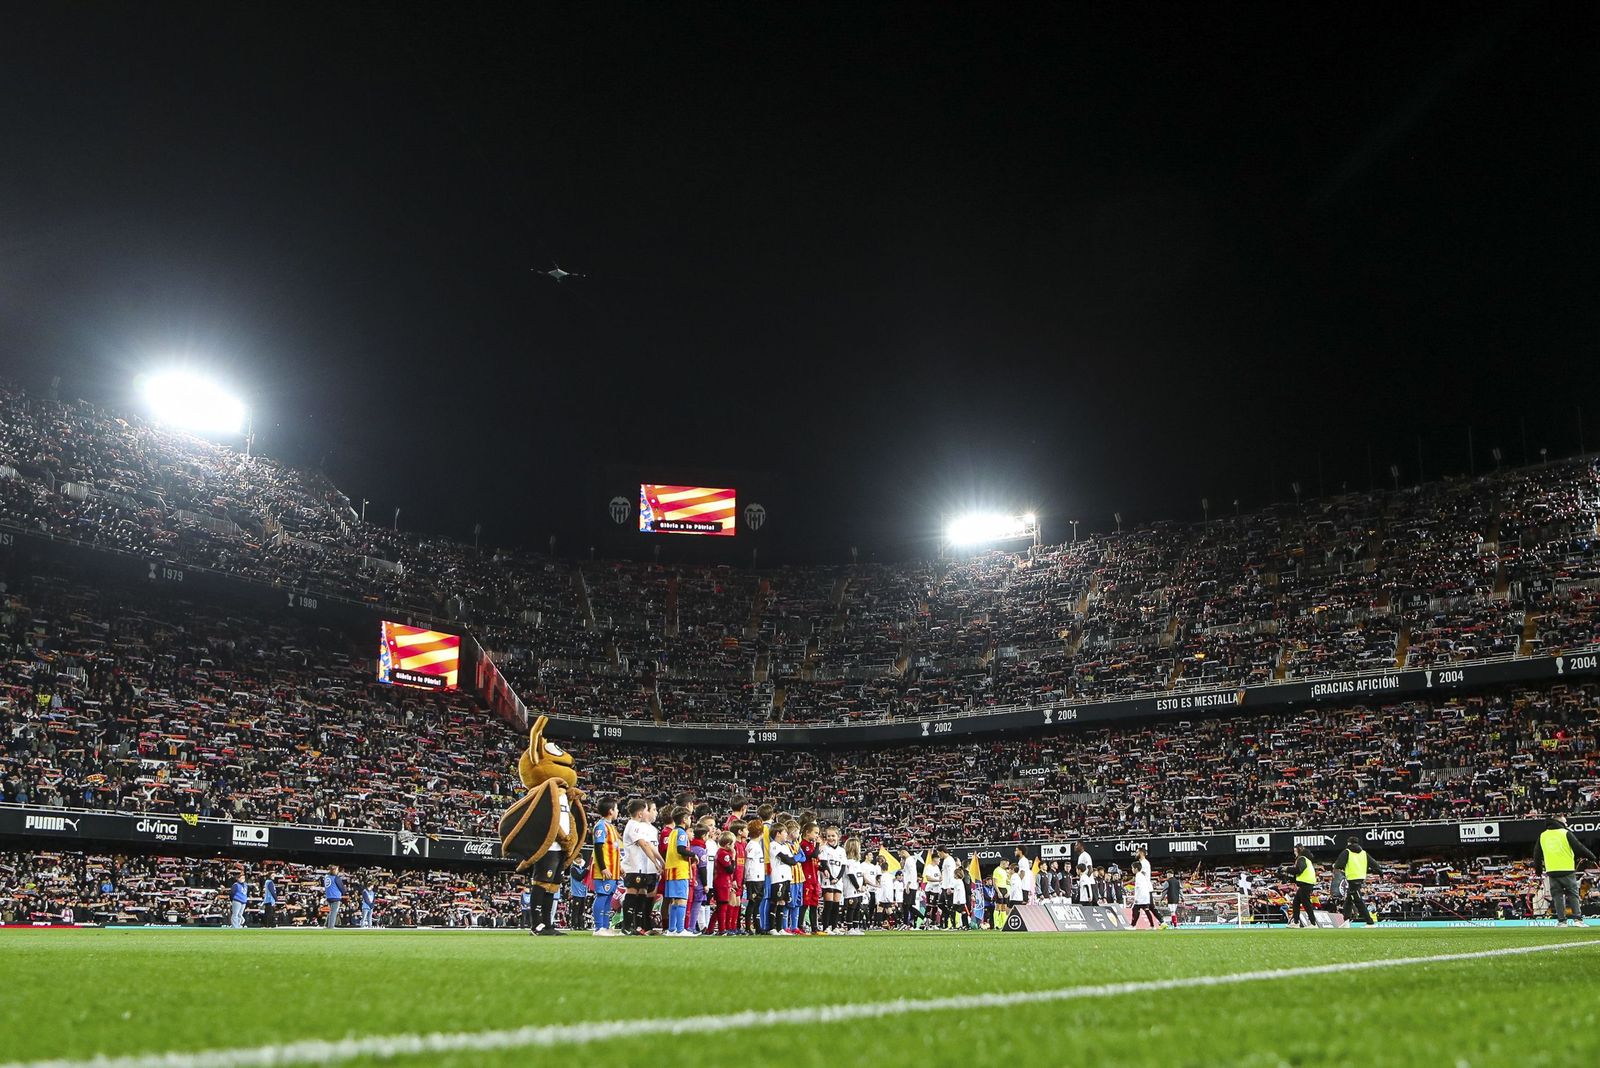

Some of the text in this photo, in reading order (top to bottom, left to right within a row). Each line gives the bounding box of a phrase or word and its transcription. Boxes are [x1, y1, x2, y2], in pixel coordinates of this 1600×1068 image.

[162, 567, 184, 582] 1979
[299, 596, 318, 609] 1980
[1570, 656, 1597, 670] 2004
[1439, 670, 1464, 683] 2004
[1311, 675, 1399, 698] ¡GRACIAS AFICIÓN!
[1157, 693, 1239, 711] ESTO ES MESTALLA
[1057, 709, 1077, 721] 2004
[603, 726, 622, 737] 1999
[934, 722, 952, 733] 2002
[758, 731, 777, 742] 1999
[1019, 767, 1050, 776] SKODA
[25, 815, 65, 831] PUMA
[136, 819, 178, 834] divina
[1567, 823, 1600, 832] KODA
[155, 833, 177, 841] seguros
[235, 829, 248, 838] TM
[1366, 828, 1404, 841] divina
[314, 836, 354, 847] SKODA
[1115, 840, 1148, 852] divina
[1169, 841, 1197, 852] PUMA
[1238, 838, 1249, 846] TM
[1294, 835, 1325, 847] PUMA
